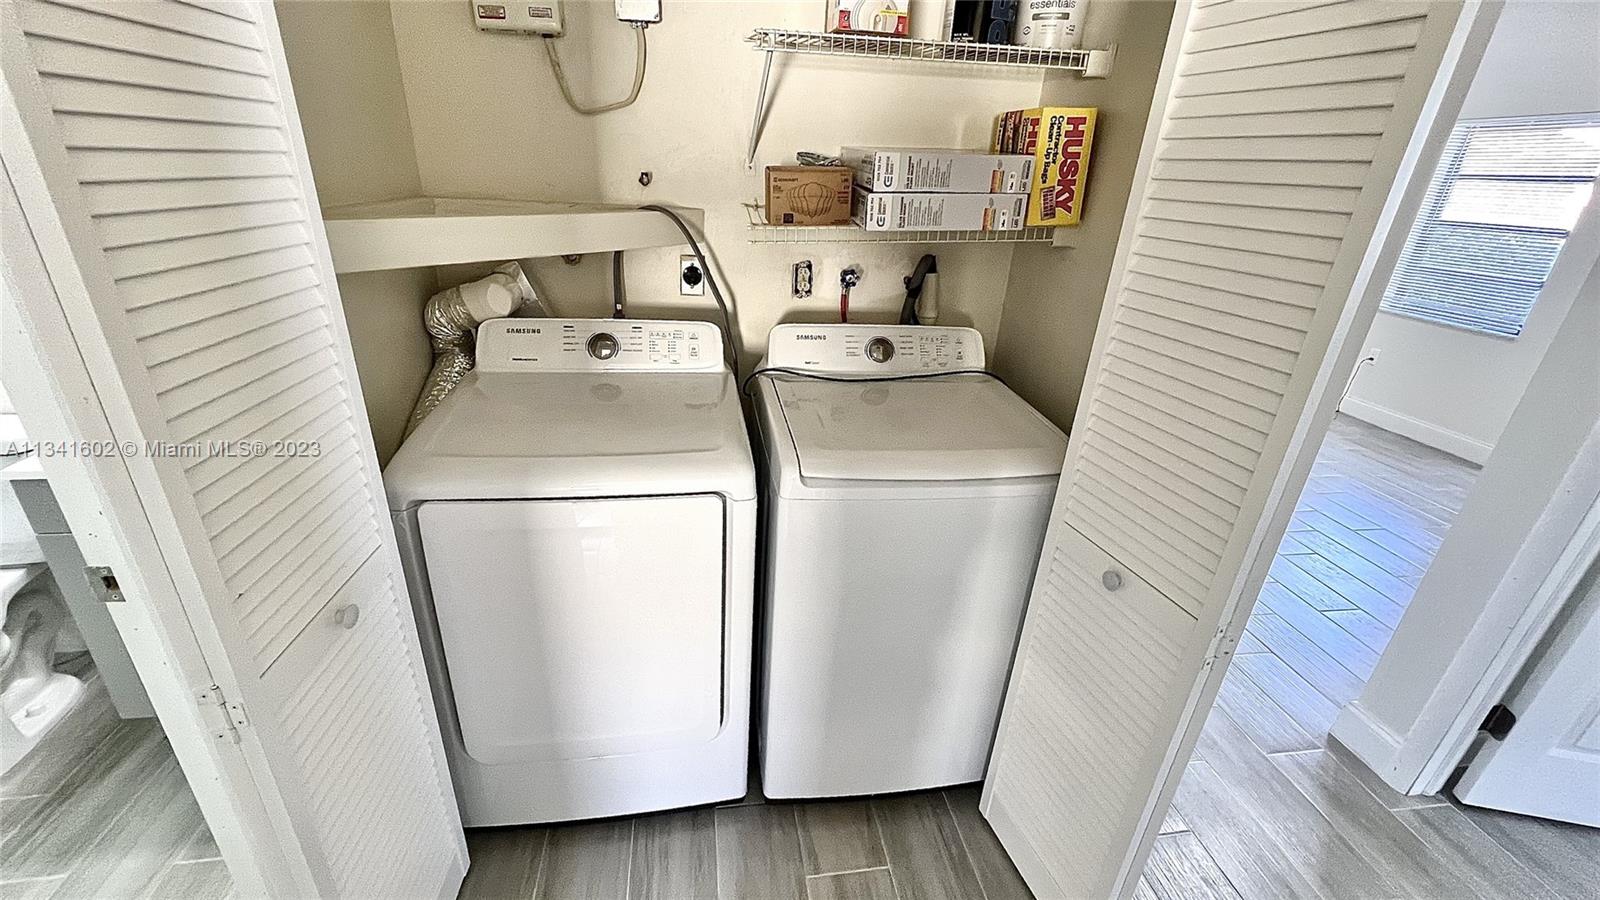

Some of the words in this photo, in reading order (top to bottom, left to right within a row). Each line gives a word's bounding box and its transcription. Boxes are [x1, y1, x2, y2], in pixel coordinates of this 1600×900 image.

[1030, 0, 1076, 9] essentials
[1052, 116, 1065, 165] Contractor
[1041, 161, 1051, 184] Bags
[1055, 116, 1087, 215] HUSKY
